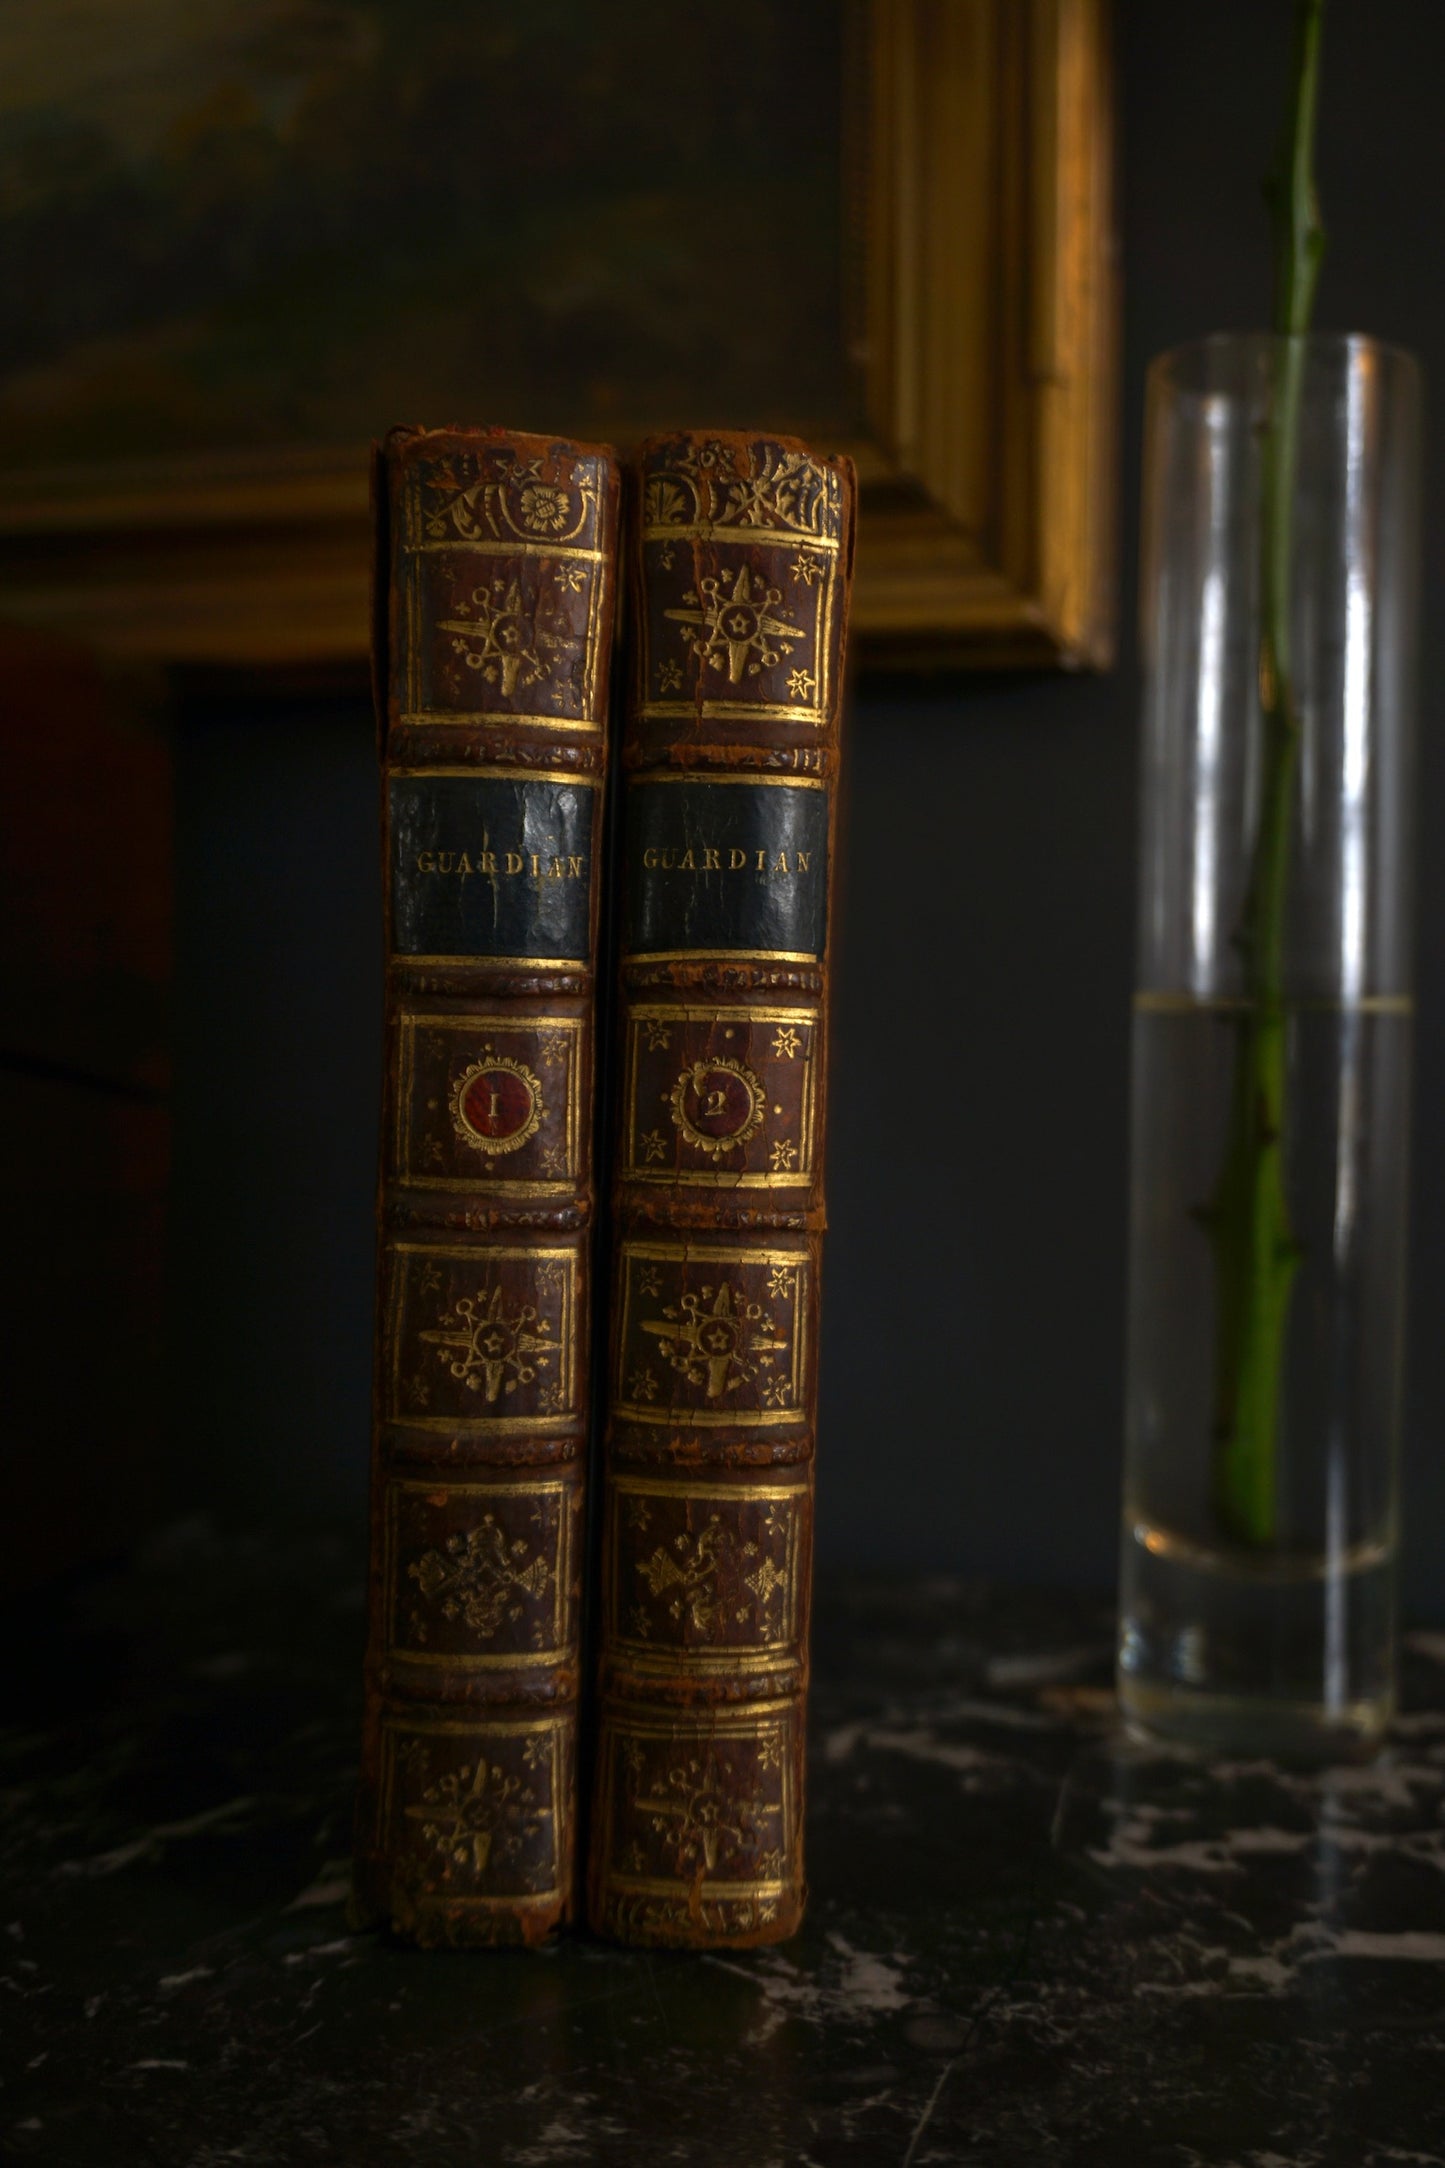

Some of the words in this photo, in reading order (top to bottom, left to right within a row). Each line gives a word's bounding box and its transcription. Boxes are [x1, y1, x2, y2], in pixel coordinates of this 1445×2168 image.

[416, 851, 584, 878] GUARDIAN
[642, 847, 812, 873] GUARDIAN
[704, 1090, 727, 1117] 2
